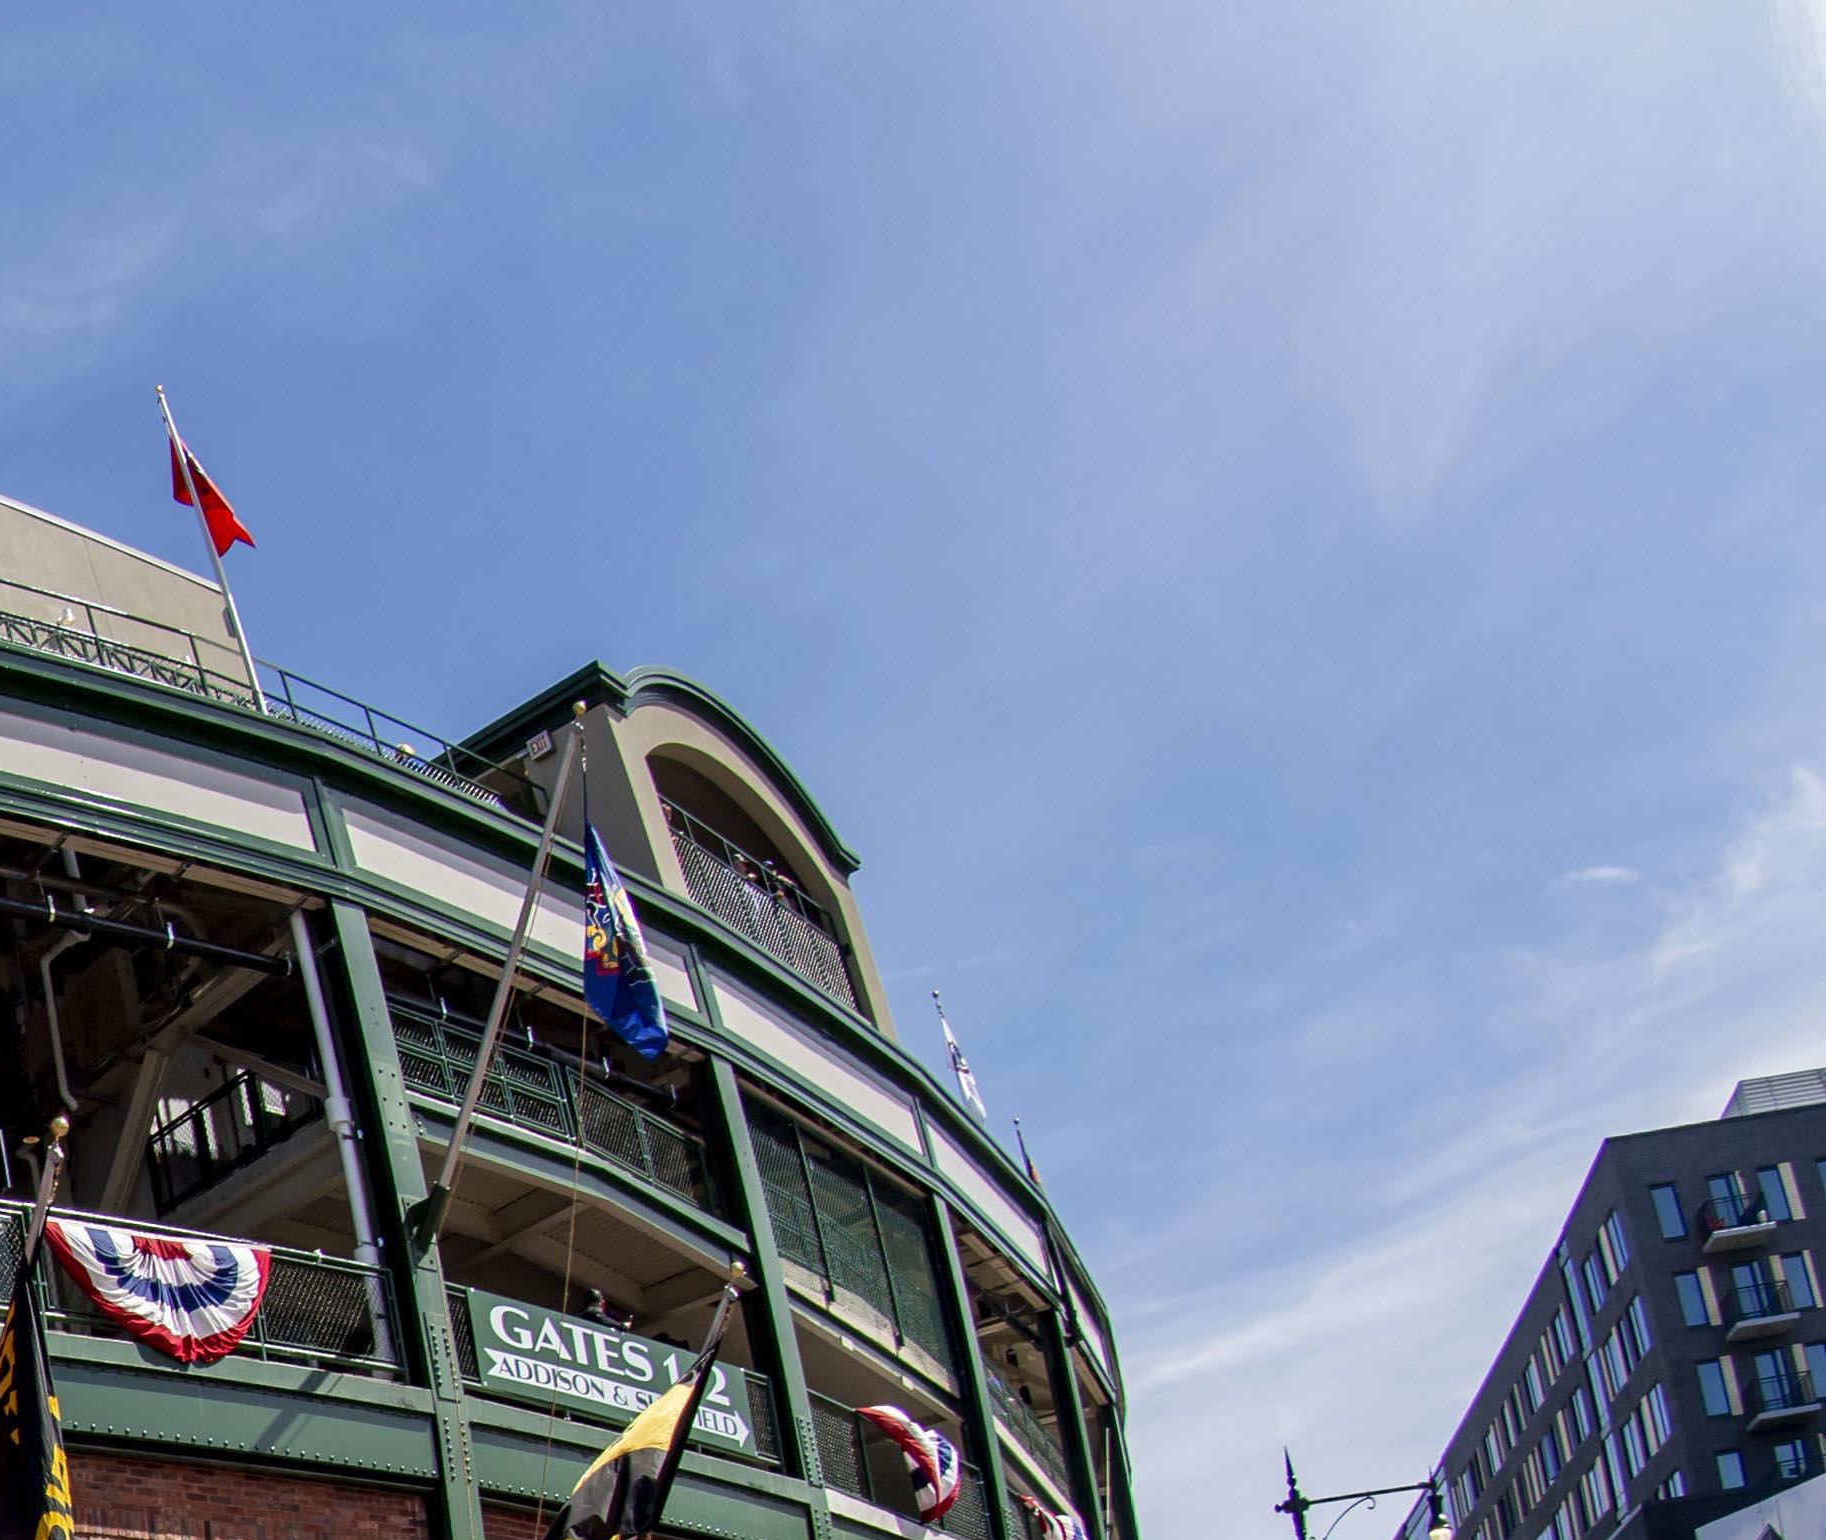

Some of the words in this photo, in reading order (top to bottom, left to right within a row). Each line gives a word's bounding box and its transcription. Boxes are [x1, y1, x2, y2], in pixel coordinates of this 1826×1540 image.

[489, 1305, 653, 1382] GATES
[663, 1353, 680, 1385] 1
[705, 1366, 731, 1407] 2
[498, 1357, 605, 1399] ADDISON
[614, 1385, 629, 1407] &
